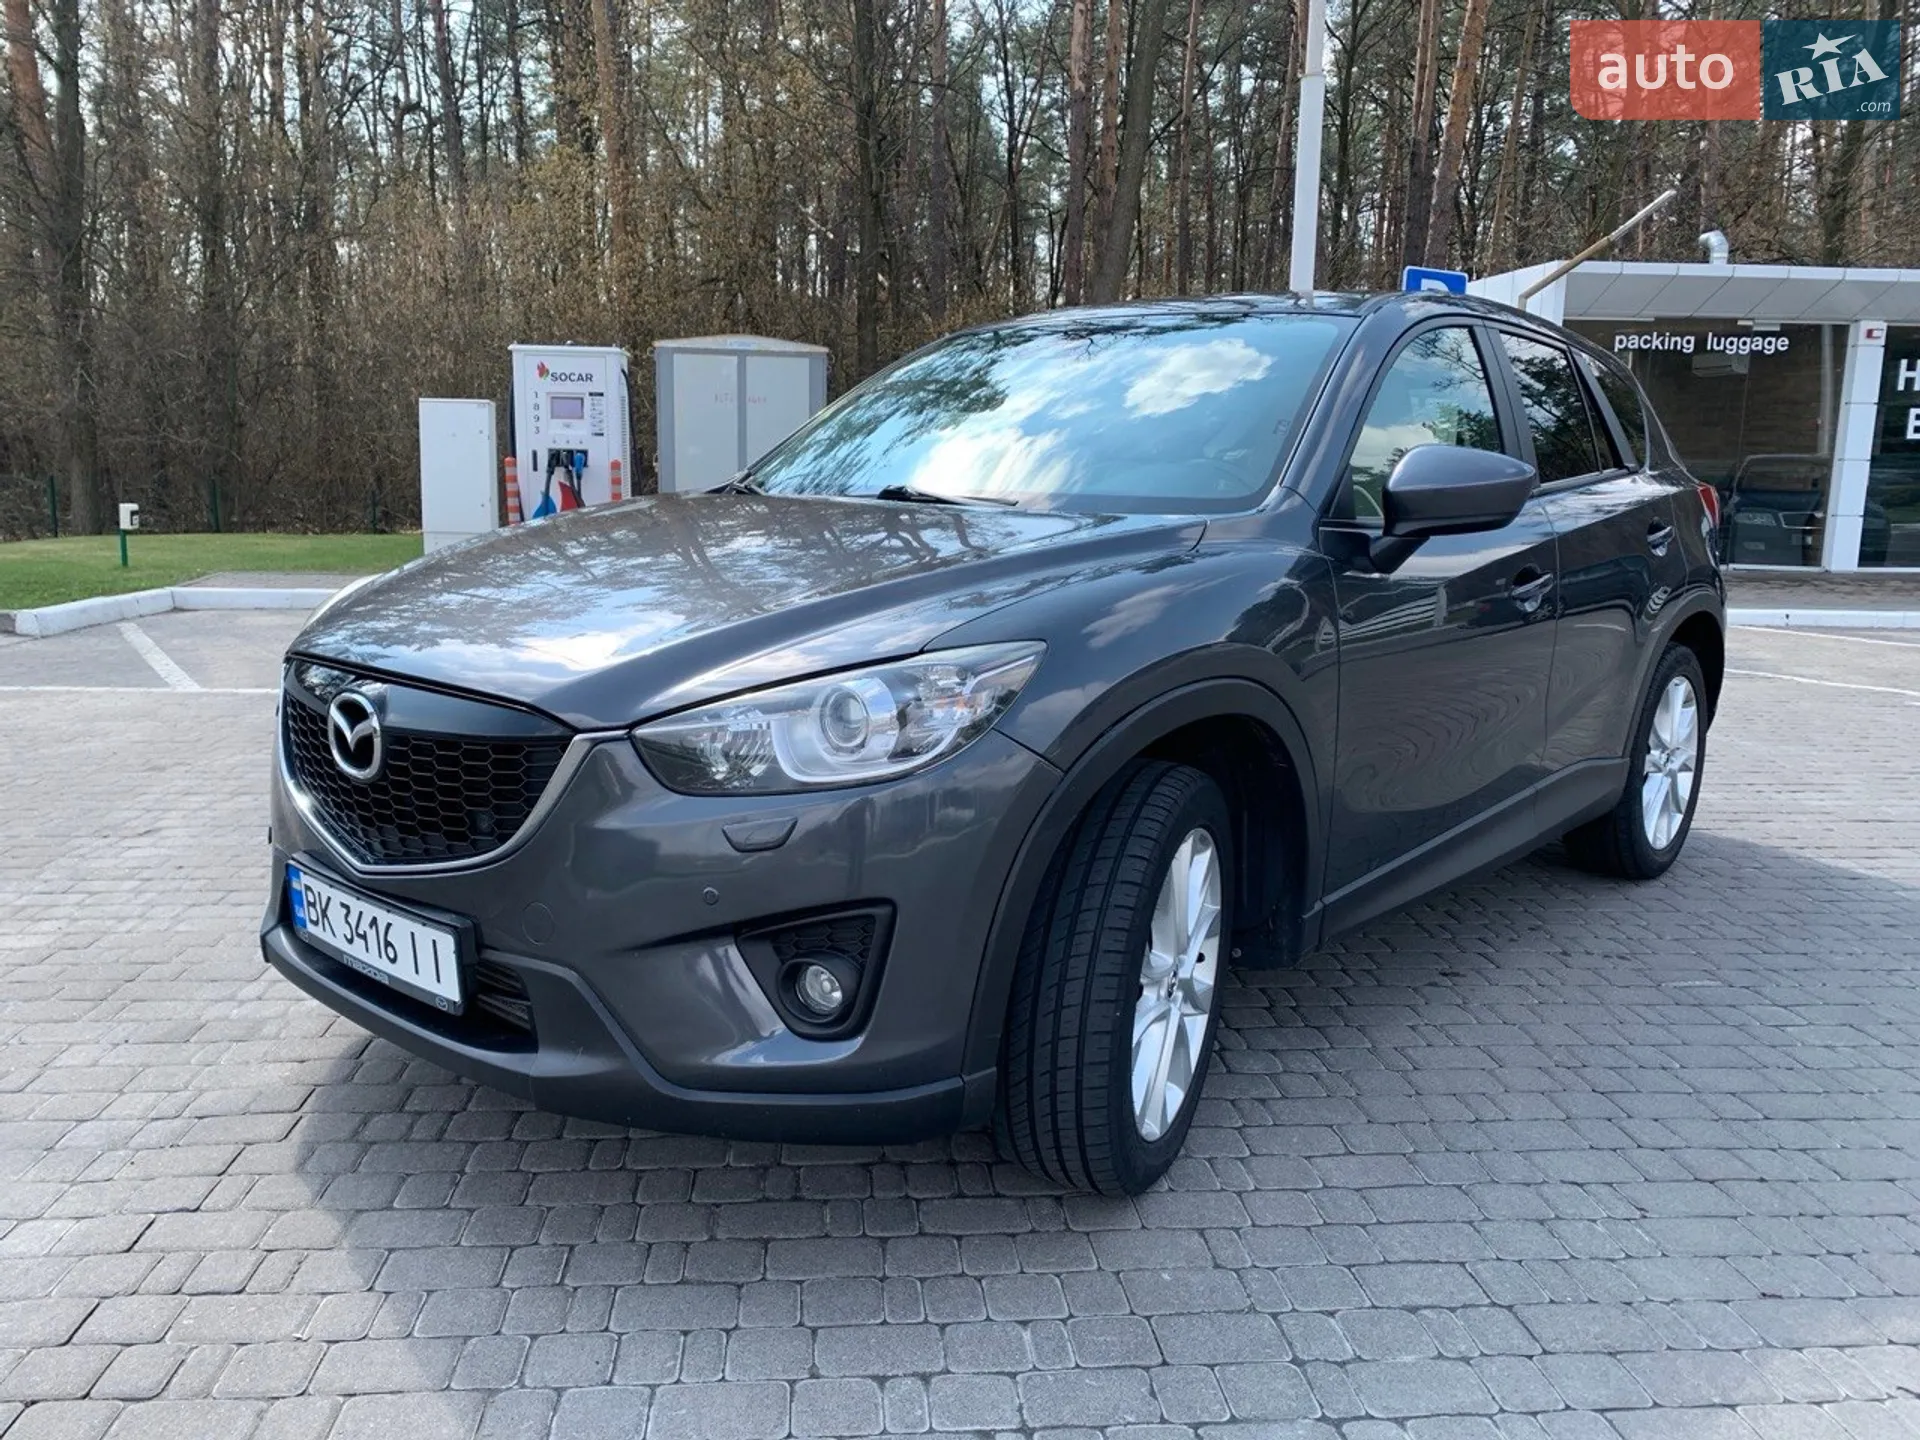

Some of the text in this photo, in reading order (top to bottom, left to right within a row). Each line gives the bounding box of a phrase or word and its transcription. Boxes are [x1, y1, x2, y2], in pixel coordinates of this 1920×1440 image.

[1614, 332, 1790, 355] packing luggage
[550, 371, 594, 383] SOCAR
[304, 884, 337, 938] BK
[340, 902, 399, 965] 3416
